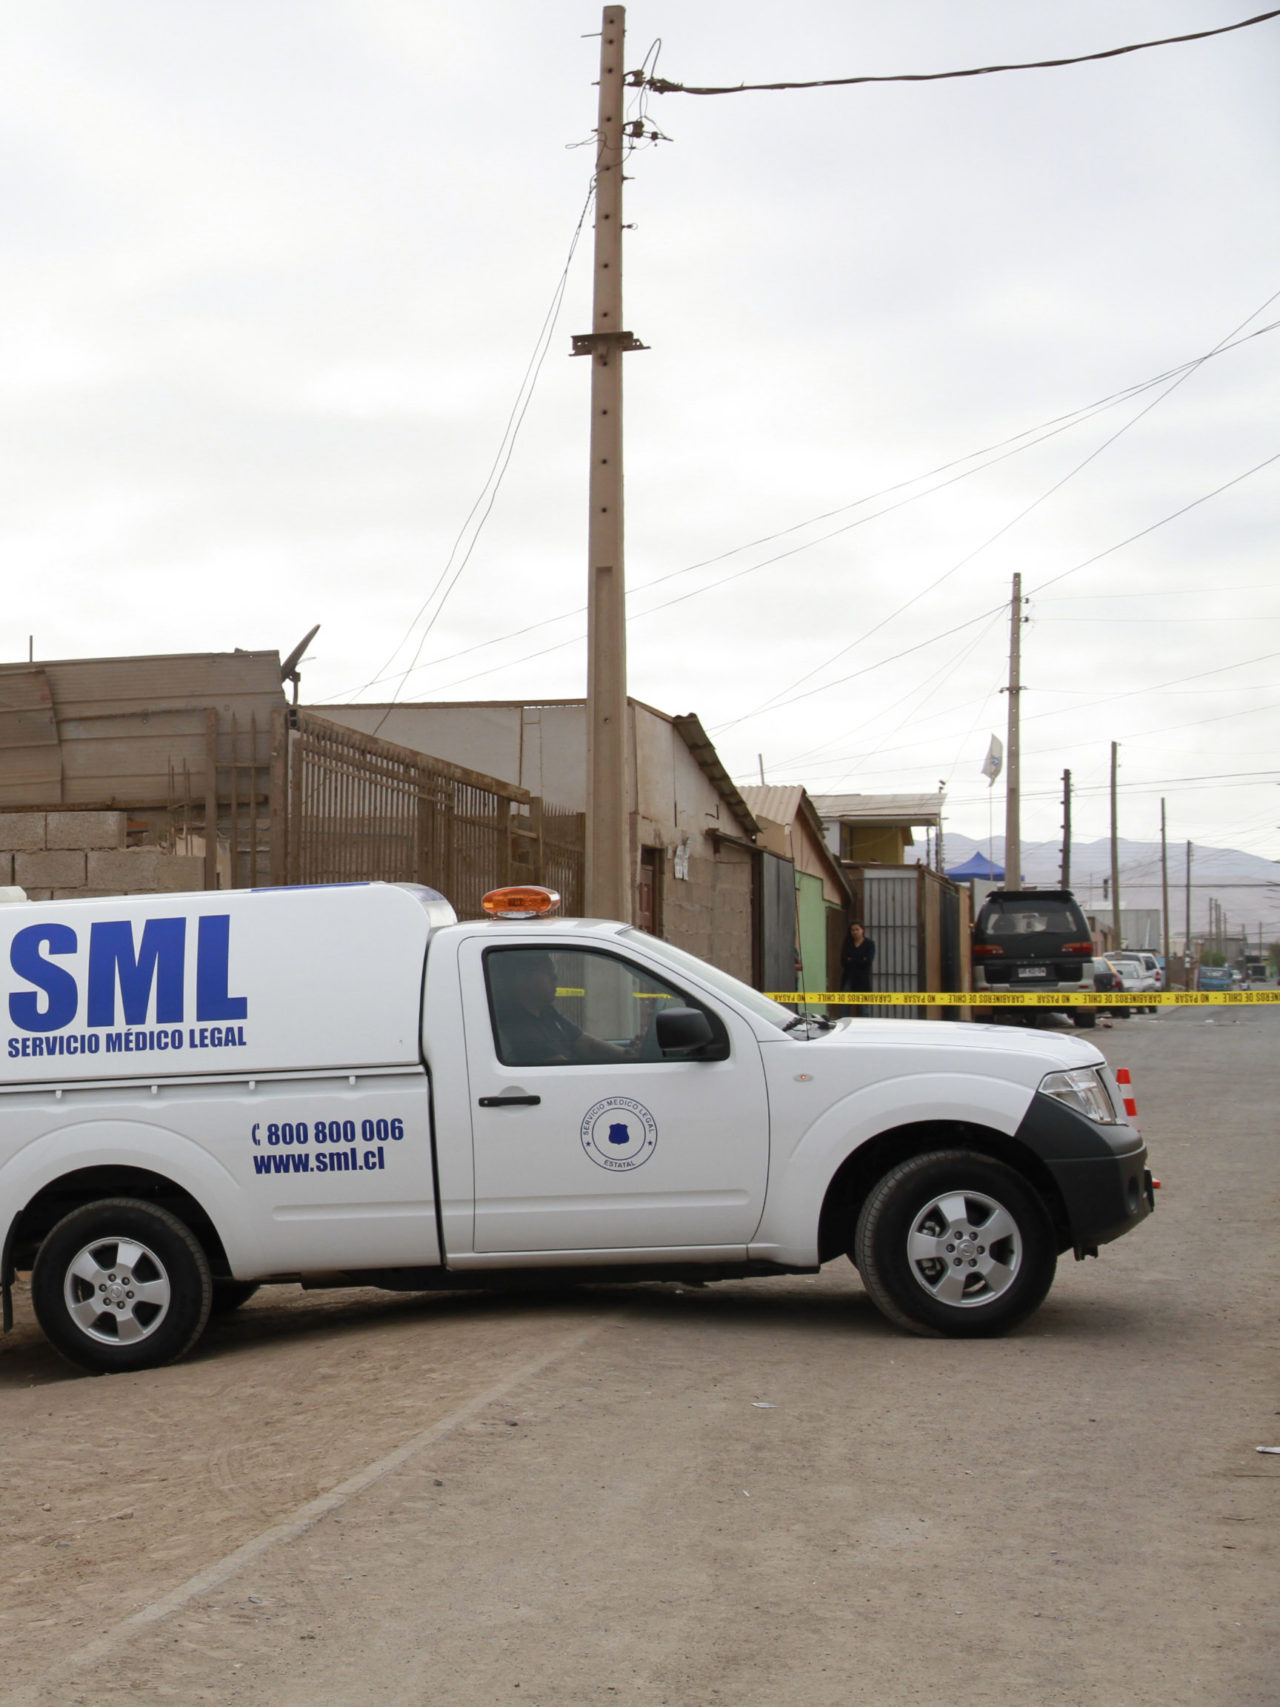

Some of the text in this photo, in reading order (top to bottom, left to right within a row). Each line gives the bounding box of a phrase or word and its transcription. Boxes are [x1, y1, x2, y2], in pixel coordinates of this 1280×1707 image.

[8, 914, 248, 1033] SML
[773, 994, 795, 1002] PASAR
[796, 994, 806, 1002] NO
[817, 994, 835, 1002] CHILE
[838, 994, 846, 1002] DE
[847, 994, 892, 1003] CARABINEROS
[904, 995, 926, 1003] PASAR
[927, 995, 936, 1003] NO
[947, 995, 967, 1003] CHILE
[968, 995, 977, 1003] DE
[979, 994, 1025, 1003] CARABINEROS
[1037, 995, 1059, 1003] PASAR
[1061, 995, 1070, 1003] NO
[1082, 995, 1102, 1003] CHILE
[1104, 994, 1113, 1003] DE
[1115, 994, 1162, 1003] CARABINEROS
[1175, 994, 1198, 1003] PASAR
[1200, 994, 1210, 1002] NO
[1223, 993, 1243, 1003] CHILE
[1245, 993, 1254, 1002] DE
[8, 1026, 247, 1058] SERVICIO MÉDICO LEGAL
[582, 1103, 605, 1136] SERVICIO
[638, 1108, 655, 1134] LEGAL
[267, 1118, 404, 1146] 800 800 006
[253, 1146, 385, 1174] www.sml.cl
[603, 1159, 636, 1168] ESTATAL
